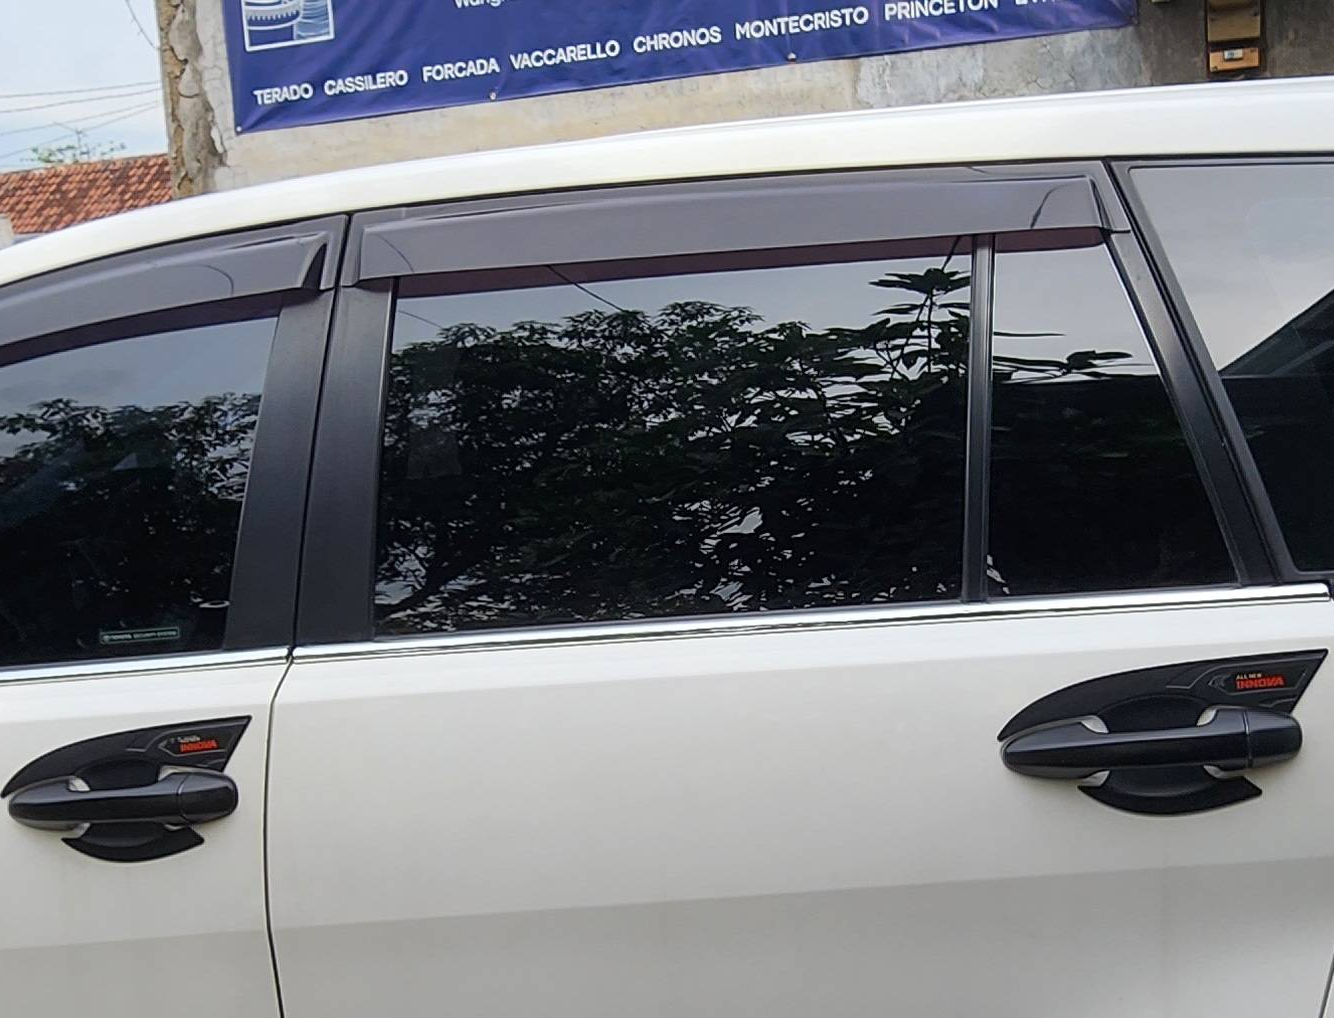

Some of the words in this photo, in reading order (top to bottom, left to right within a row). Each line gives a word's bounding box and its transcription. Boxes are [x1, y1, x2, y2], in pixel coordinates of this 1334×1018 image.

[252, 82, 314, 105] TERADO
[323, 69, 409, 96] CASSILERO
[422, 57, 500, 83] FORCADA
[509, 39, 621, 70] VACCARELLO
[632, 25, 722, 53] CHRONOS
[734, 6, 869, 40] MONTECRISTO
[884, 0, 999, 21] PRINCETON
[1236, 676, 1284, 689] INNOVA
